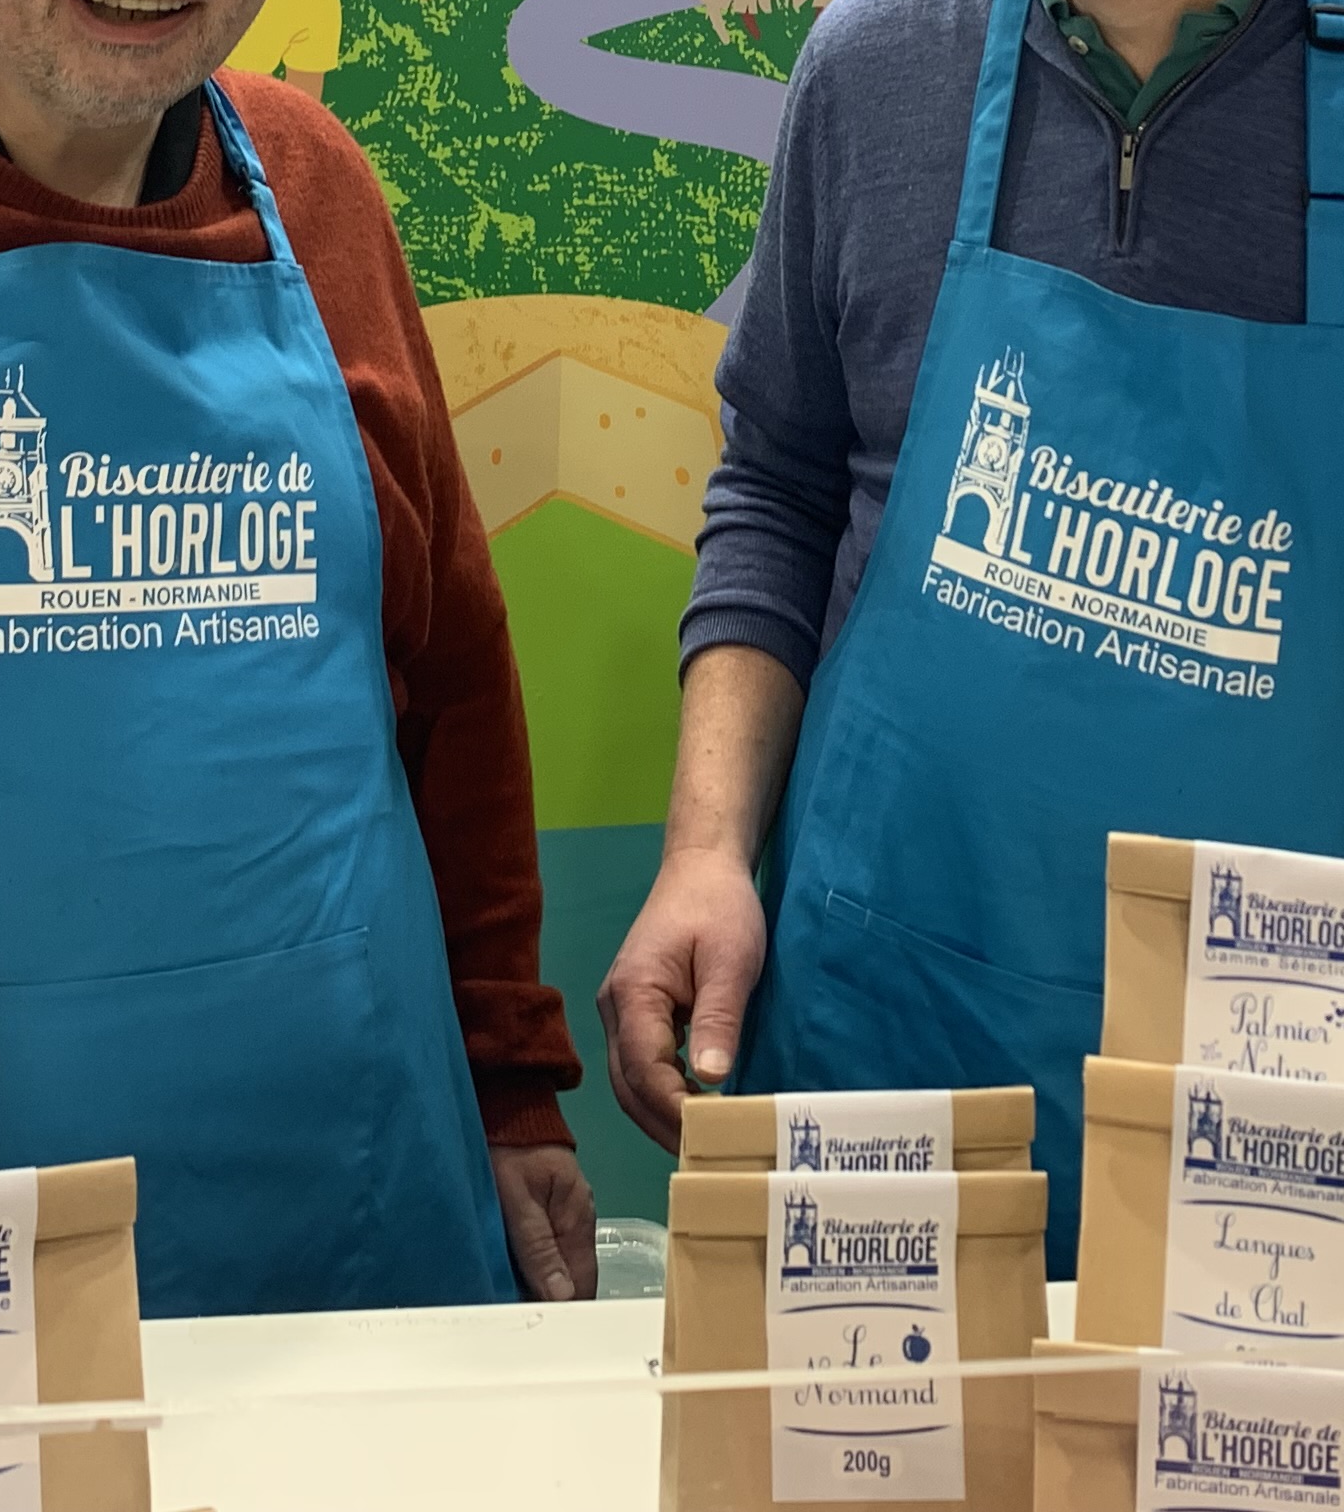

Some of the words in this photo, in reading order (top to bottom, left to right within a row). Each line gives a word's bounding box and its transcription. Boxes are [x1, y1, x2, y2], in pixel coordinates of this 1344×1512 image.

[59, 451, 273, 499] Biscuiterie
[278, 451, 315, 494] de
[1030, 445, 1243, 546] Biscuiterie
[1248, 509, 1294, 552] de
[60, 500, 317, 579] L'HORLOGE
[1008, 491, 1291, 631] L'HORLOGE
[41, 589, 122, 609] ROUEN
[142, 583, 262, 607] NORMANDIE
[984, 561, 1053, 602] ROUEN
[1071, 587, 1208, 648] NORMANDIE
[175, 606, 321, 646] Artisanale
[921, 563, 1086, 653] Fabrication
[1094, 629, 1276, 700] Artisanale
[1245, 893, 1338, 920] Biscuiterie
[1204, 949, 1270, 968] Gamme
[1230, 992, 1331, 1044] Palmier
[825, 1136, 912, 1155] Biscuiterie
[916, 1135, 935, 1150] de
[1227, 1116, 1323, 1145] Biscuiterie
[1182, 1171, 1268, 1194] Fabrication
[822, 1218, 914, 1236] Biscuiterie
[918, 1218, 939, 1234] de
[821, 1236, 939, 1265] L'HORLOGE
[1213, 1213, 1316, 1281] Langues
[781, 1277, 862, 1292] Fabrication
[866, 1276, 938, 1291] Artisanale
[1215, 1291, 1242, 1319] de
[1250, 1283, 1309, 1327] Chat
[795, 1356, 938, 1406] Normand
[1202, 1409, 1312, 1440] Biscuiterie
[1316, 1424, 1341, 1443] de
[842, 1450, 891, 1477] 200g
[1201, 1432, 1340, 1474] L'HORLOGE
[1155, 1472, 1250, 1497] Fabrication
[1254, 1482, 1341, 1507] Artisanale
